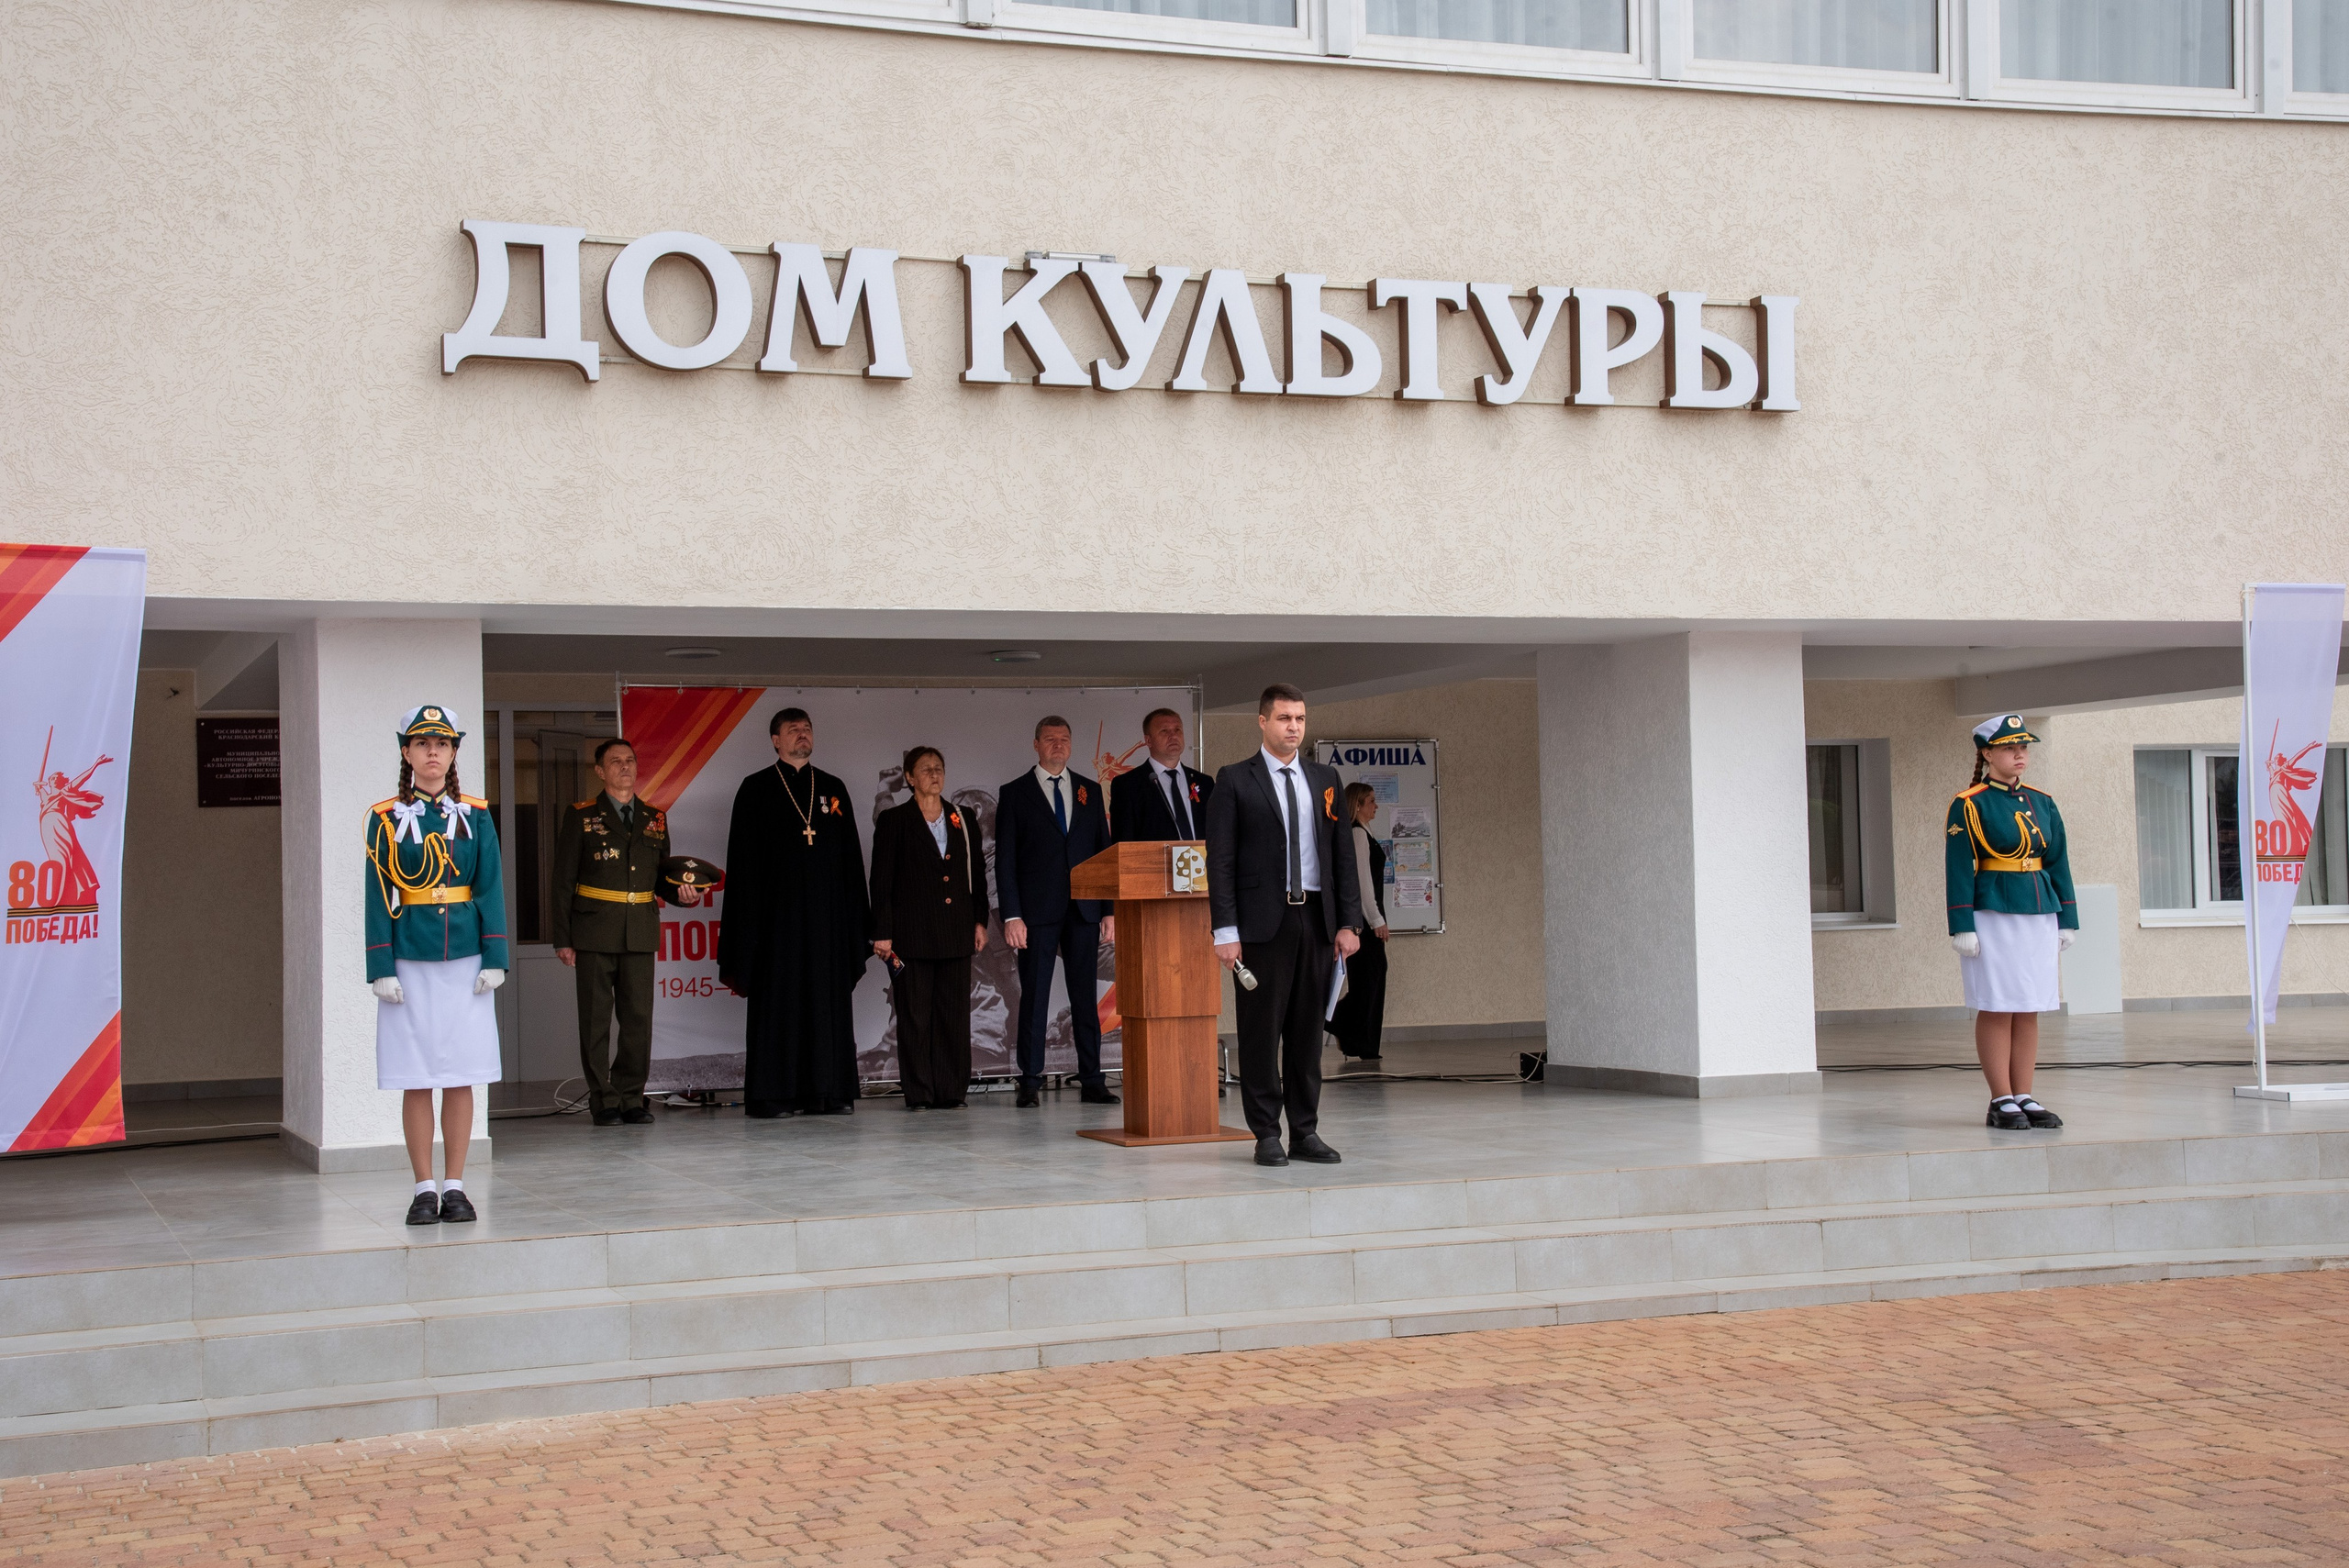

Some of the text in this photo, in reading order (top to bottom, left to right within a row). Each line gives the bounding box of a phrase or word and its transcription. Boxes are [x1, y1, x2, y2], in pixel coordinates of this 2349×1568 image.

[440, 219, 1800, 414] ДОМ КУЛЬТУРЫ
[1329, 748, 1426, 765] АФИША
[8, 860, 63, 909] 80
[2256, 863, 2303, 884] ПОБЕД
[6, 915, 98, 944] ПОБЕДА!
